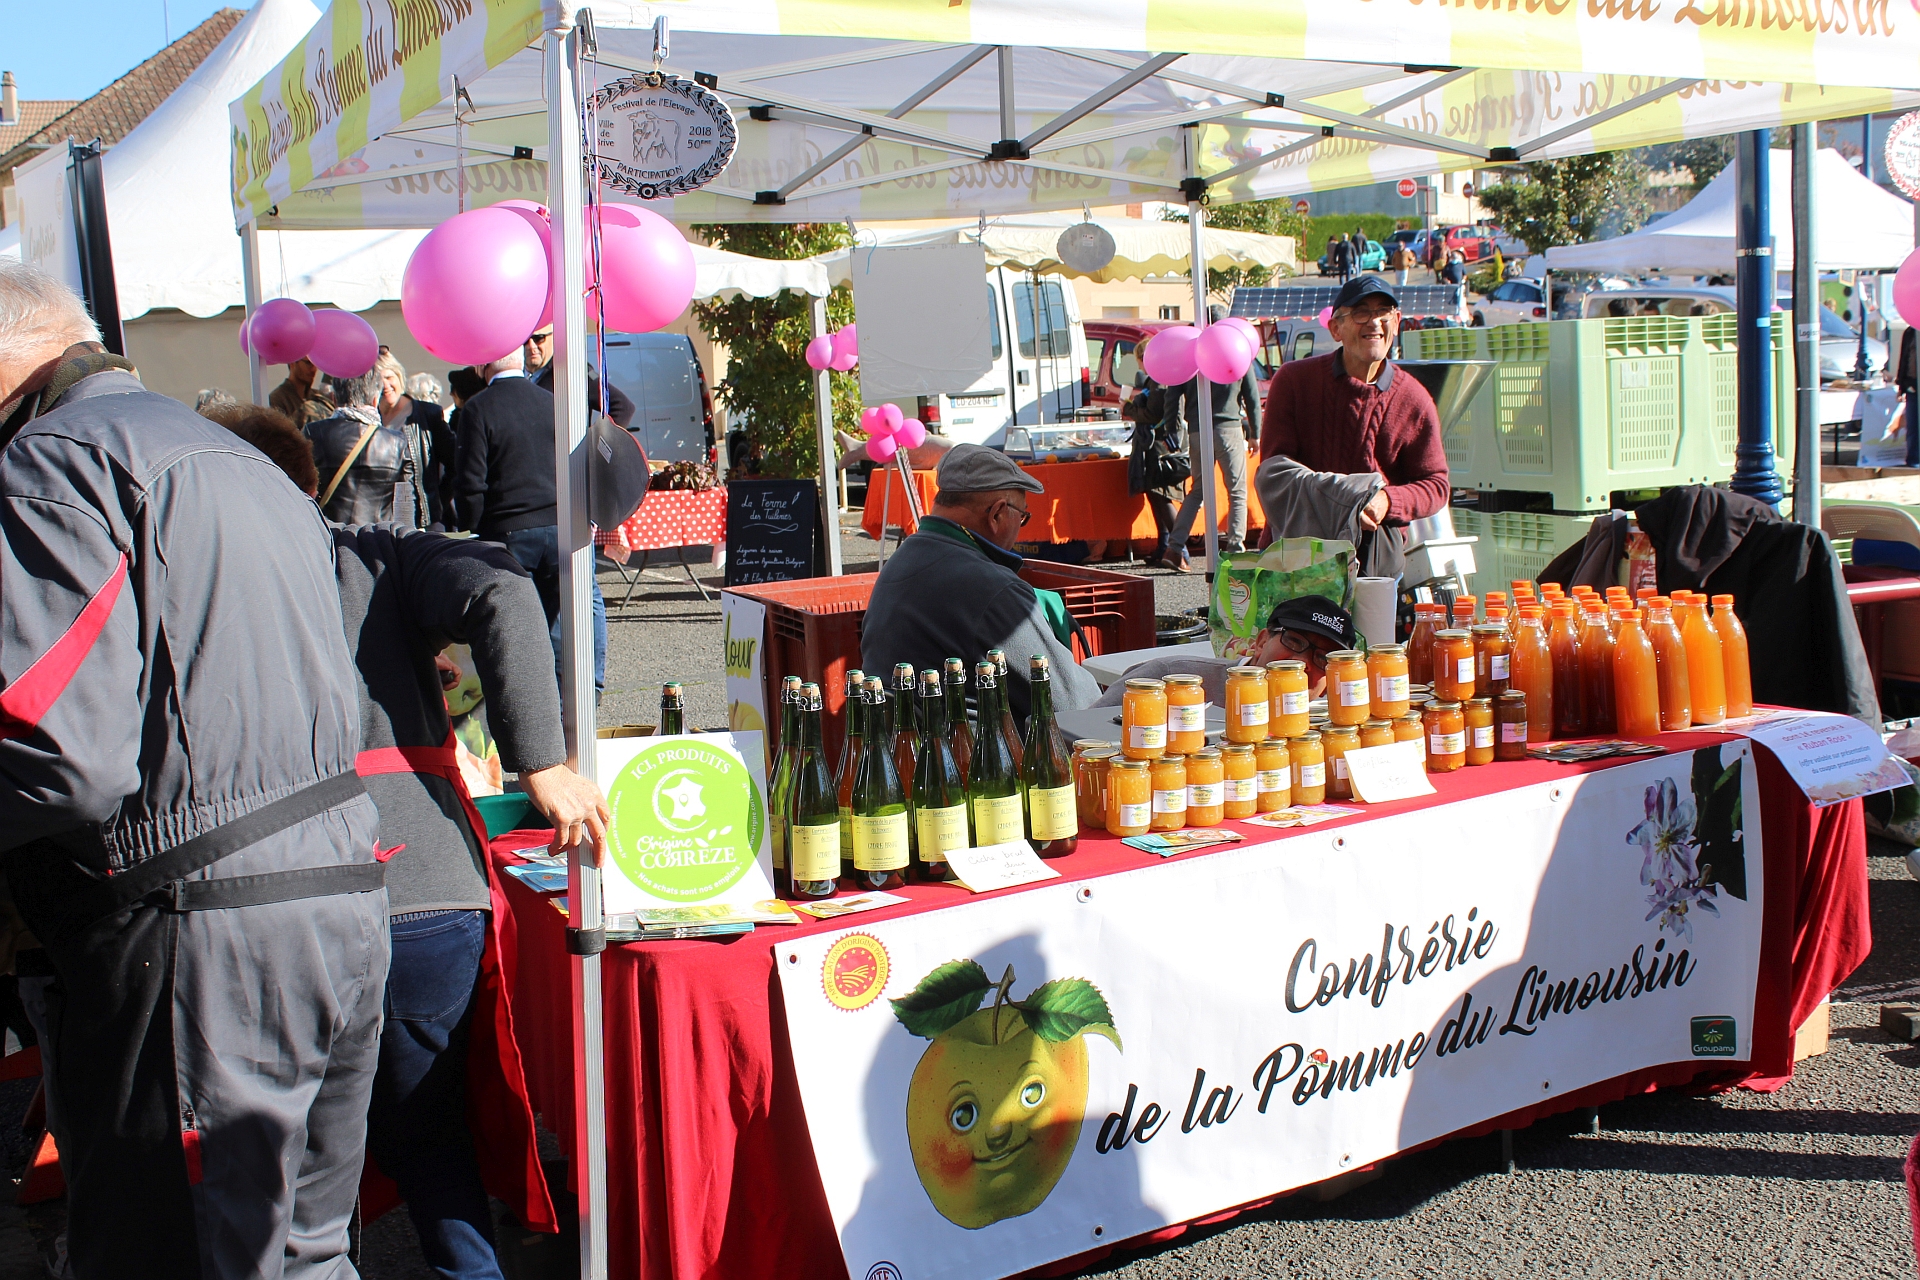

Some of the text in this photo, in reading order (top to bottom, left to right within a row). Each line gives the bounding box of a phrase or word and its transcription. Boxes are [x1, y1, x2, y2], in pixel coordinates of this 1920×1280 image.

[612, 98, 643, 113] Festival
[645, 98, 656, 107] de
[600, 130, 610, 138] de
[688, 126, 712, 136] 2018
[616, 162, 684, 179] PARTICIPATION
[1398, 184, 1415, 193] STOP
[761, 491, 787, 509] Ferme
[1802, 738, 1828, 750] Ruban
[1828, 734, 1848, 745] Rose
[656, 748, 732, 775] PRODUITS
[652, 881, 679, 896] achats
[680, 888, 698, 896] sont
[699, 884, 714, 895] nos
[713, 866, 742, 890] emplois
[827, 948, 842, 996] APPELLATION
[841, 938, 876, 950] D'ORIGINE
[1284, 905, 1501, 1014] Confrérie
[1095, 937, 1700, 1156] de la Pomme du Limousin
[1693, 1044, 1735, 1053] Groupama
